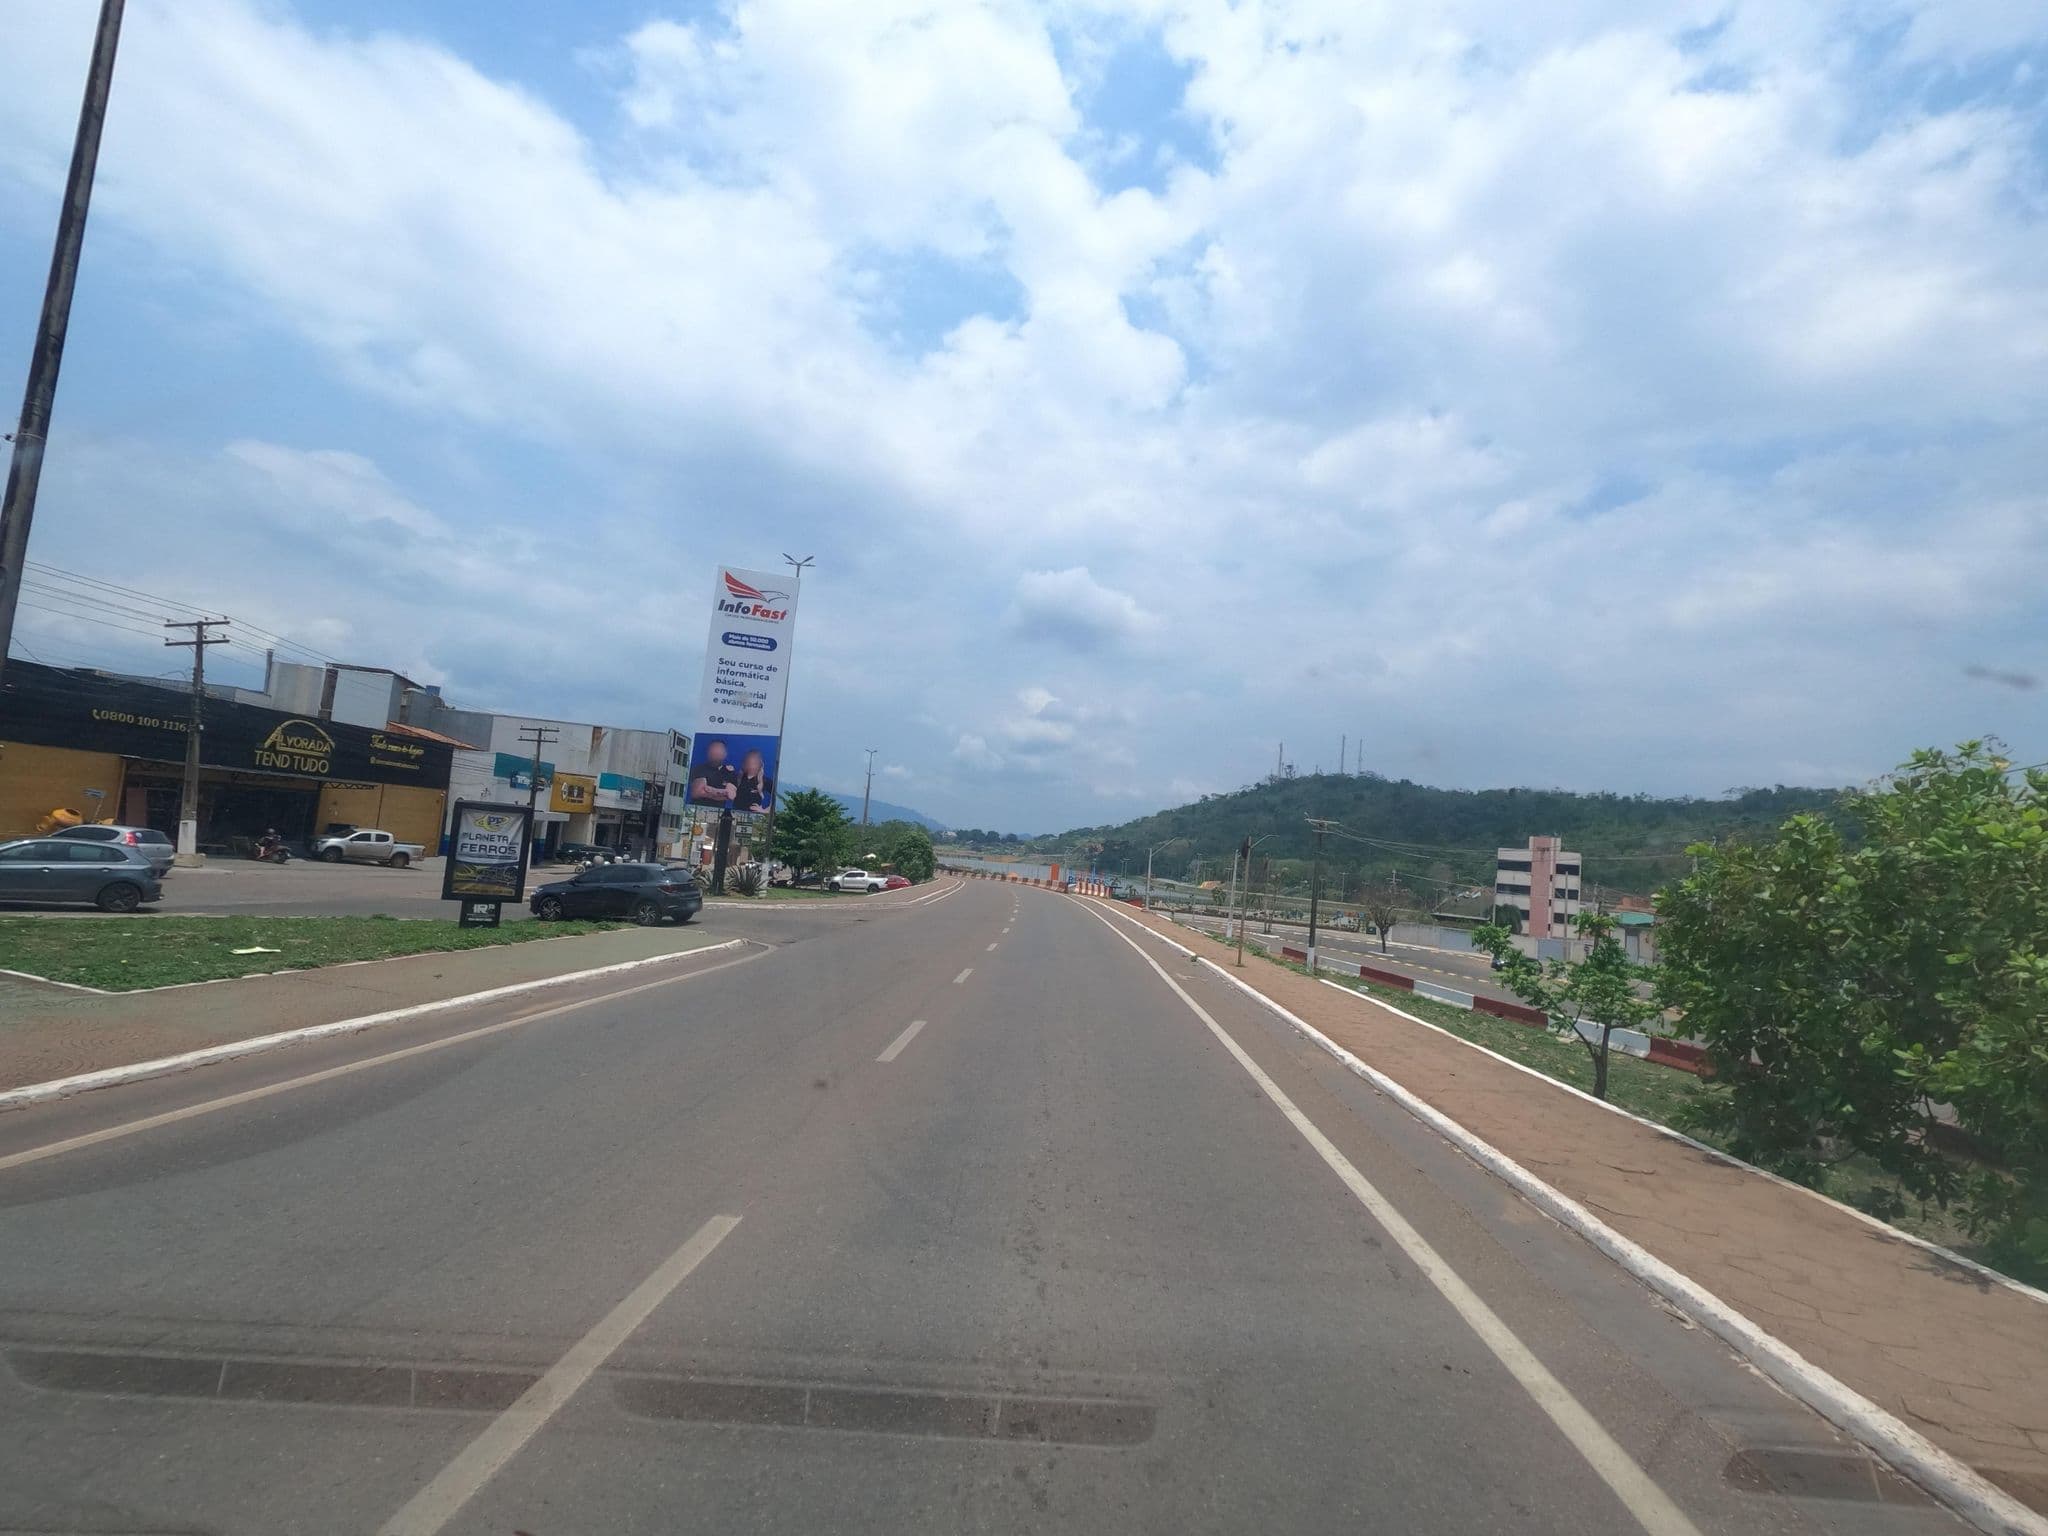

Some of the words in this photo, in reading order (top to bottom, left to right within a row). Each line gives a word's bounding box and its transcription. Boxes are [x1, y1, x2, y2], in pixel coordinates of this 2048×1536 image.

[718, 599, 787, 620] InfoFast
[718, 657, 736, 667] Seu
[739, 661, 764, 671] curso
[766, 664, 778, 673] de
[717, 666, 770, 681] informática
[714, 687, 767, 700] emprial
[720, 697, 763, 709] avançada
[100, 710, 135, 724] 0800
[137, 716, 160, 728] 100
[264, 726, 331, 753] ALVORADA
[254, 749, 290, 769] TEND
[293, 755, 330, 774] TUDO
[462, 832, 510, 845] PLANETA
[460, 842, 518, 856] FERROS
